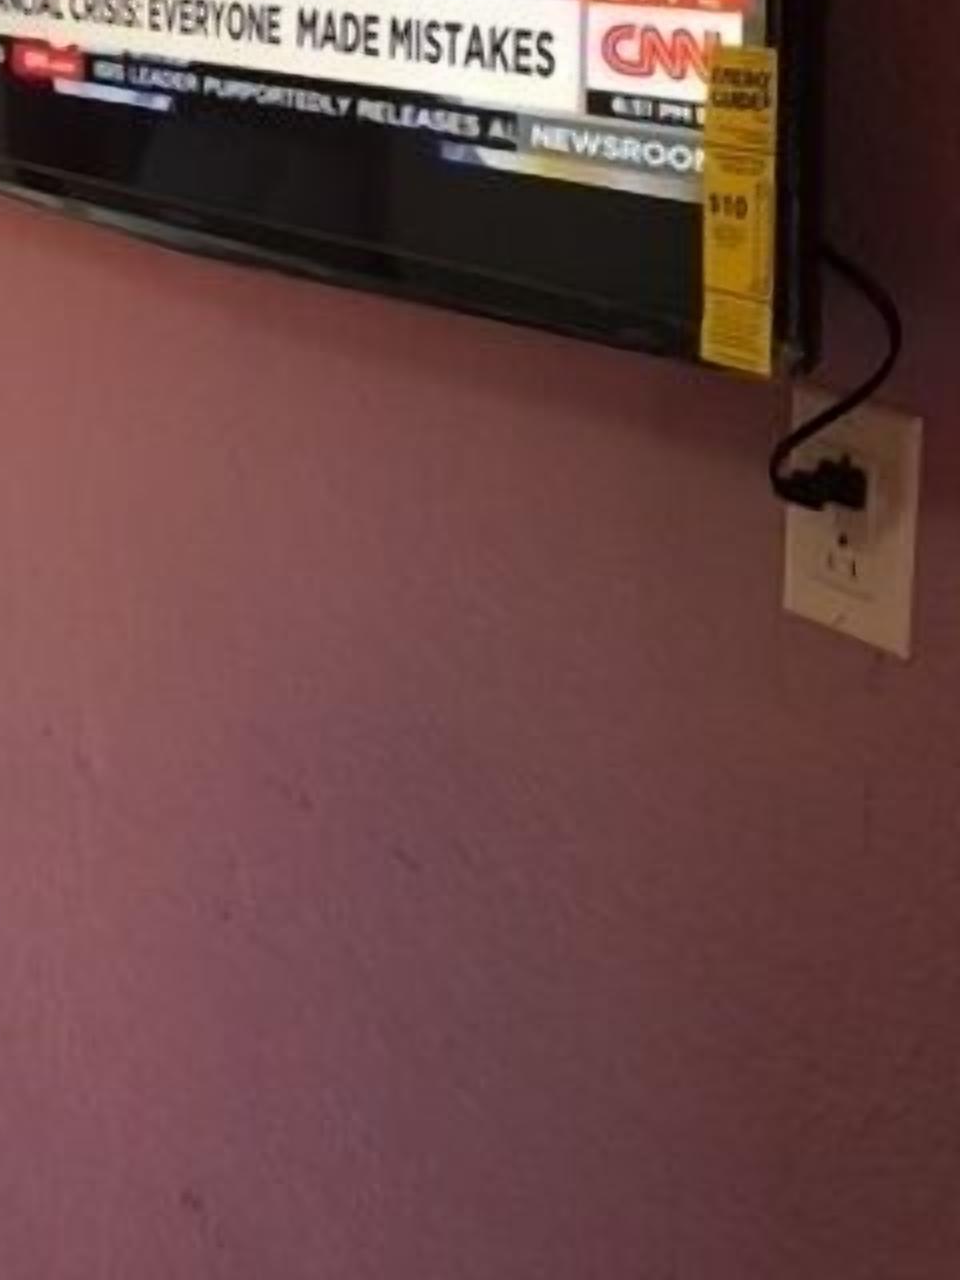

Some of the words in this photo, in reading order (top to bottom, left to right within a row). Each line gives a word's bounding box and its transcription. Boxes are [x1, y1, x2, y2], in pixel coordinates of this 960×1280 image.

[295, 6, 380, 58] MADE
[388, 17, 556, 79] MISTAKES
[600, 24, 722, 86] CNN
[128, 64, 197, 94] LEADER
